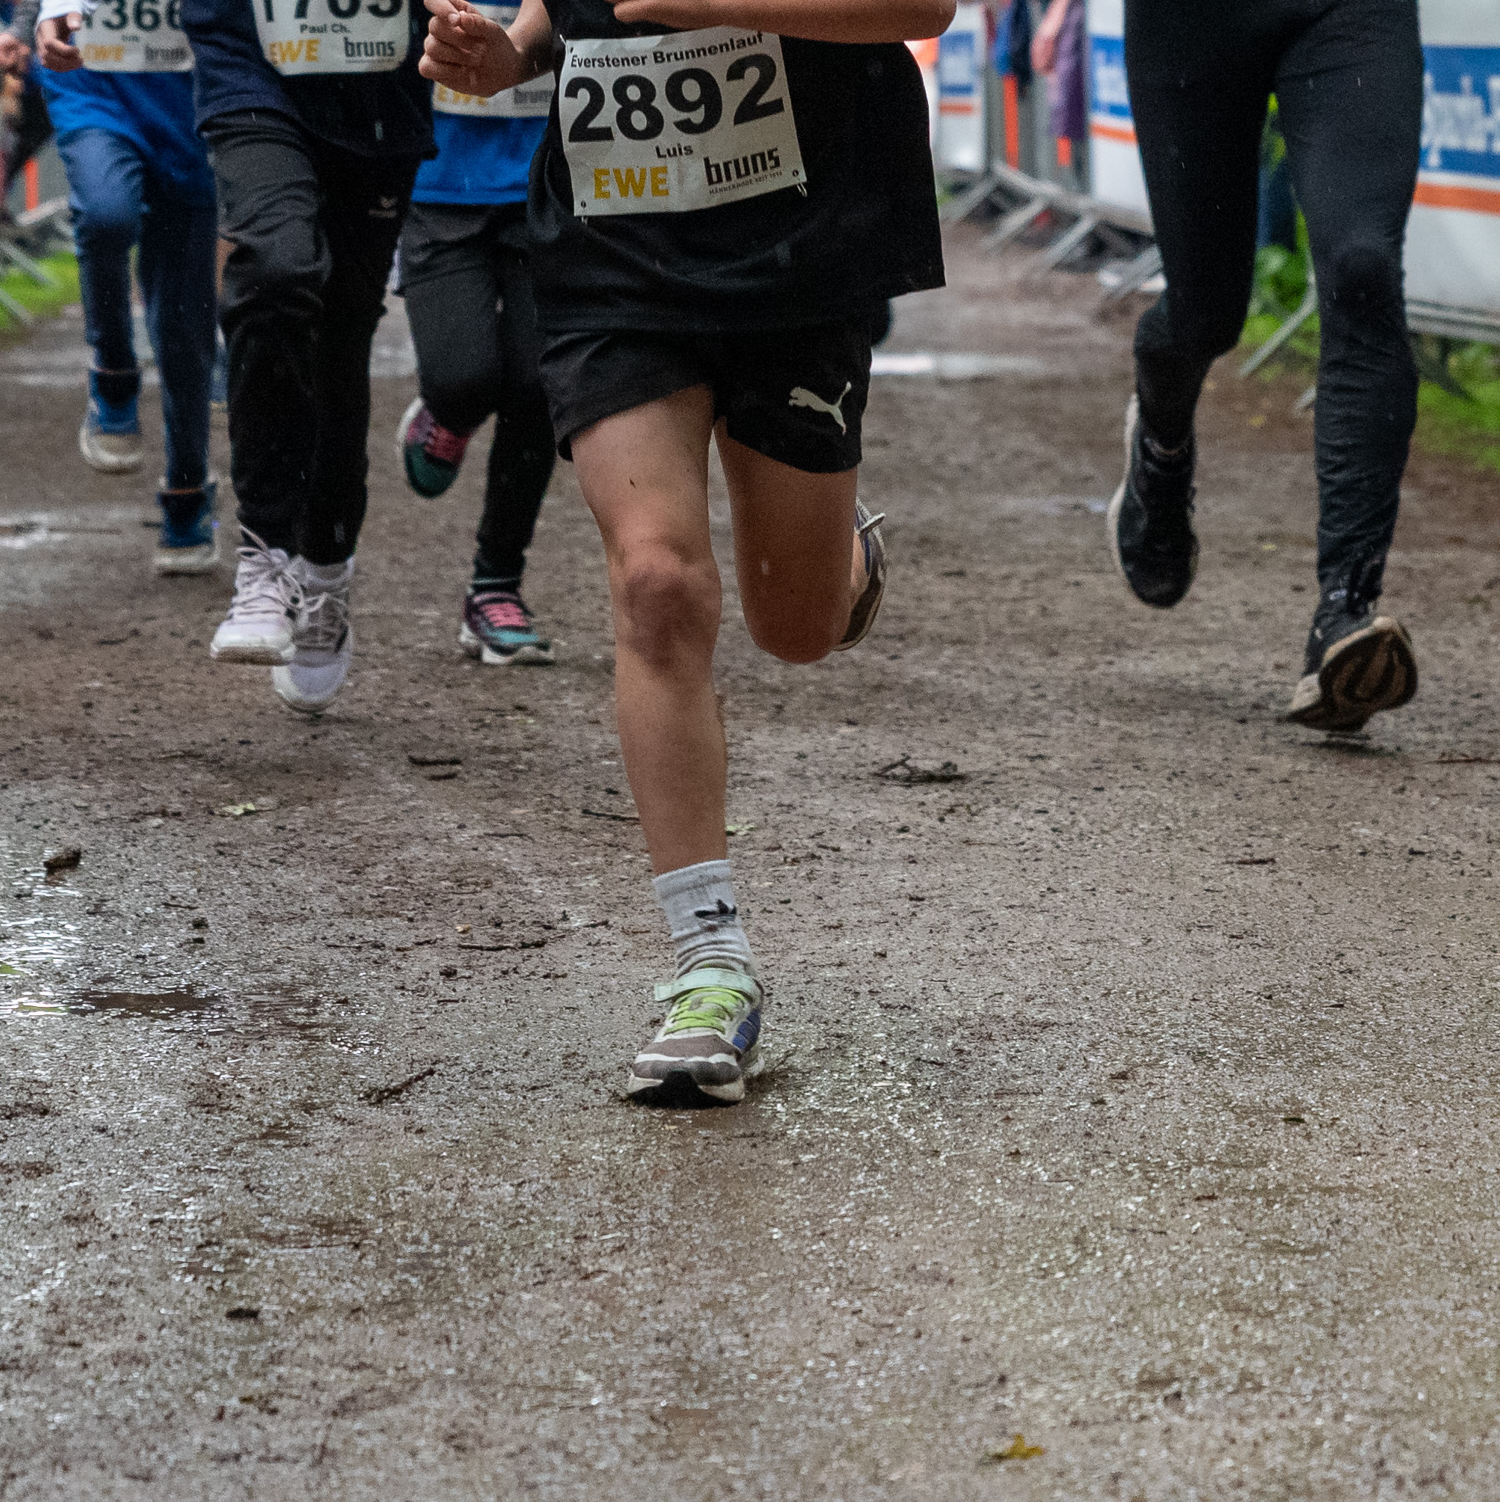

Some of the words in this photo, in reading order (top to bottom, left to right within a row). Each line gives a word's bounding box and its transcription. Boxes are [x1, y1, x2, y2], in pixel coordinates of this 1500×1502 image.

[300, 23, 327, 34] Paul
[268, 38, 321, 66] EWE
[343, 36, 396, 58] bruns
[570, 53, 648, 69] Everstener
[653, 31, 764, 64] Brunnenlauf
[564, 53, 785, 143] 2892
[655, 143, 694, 159] Luis
[593, 166, 670, 199] EWE
[703, 147, 781, 186] bruns
